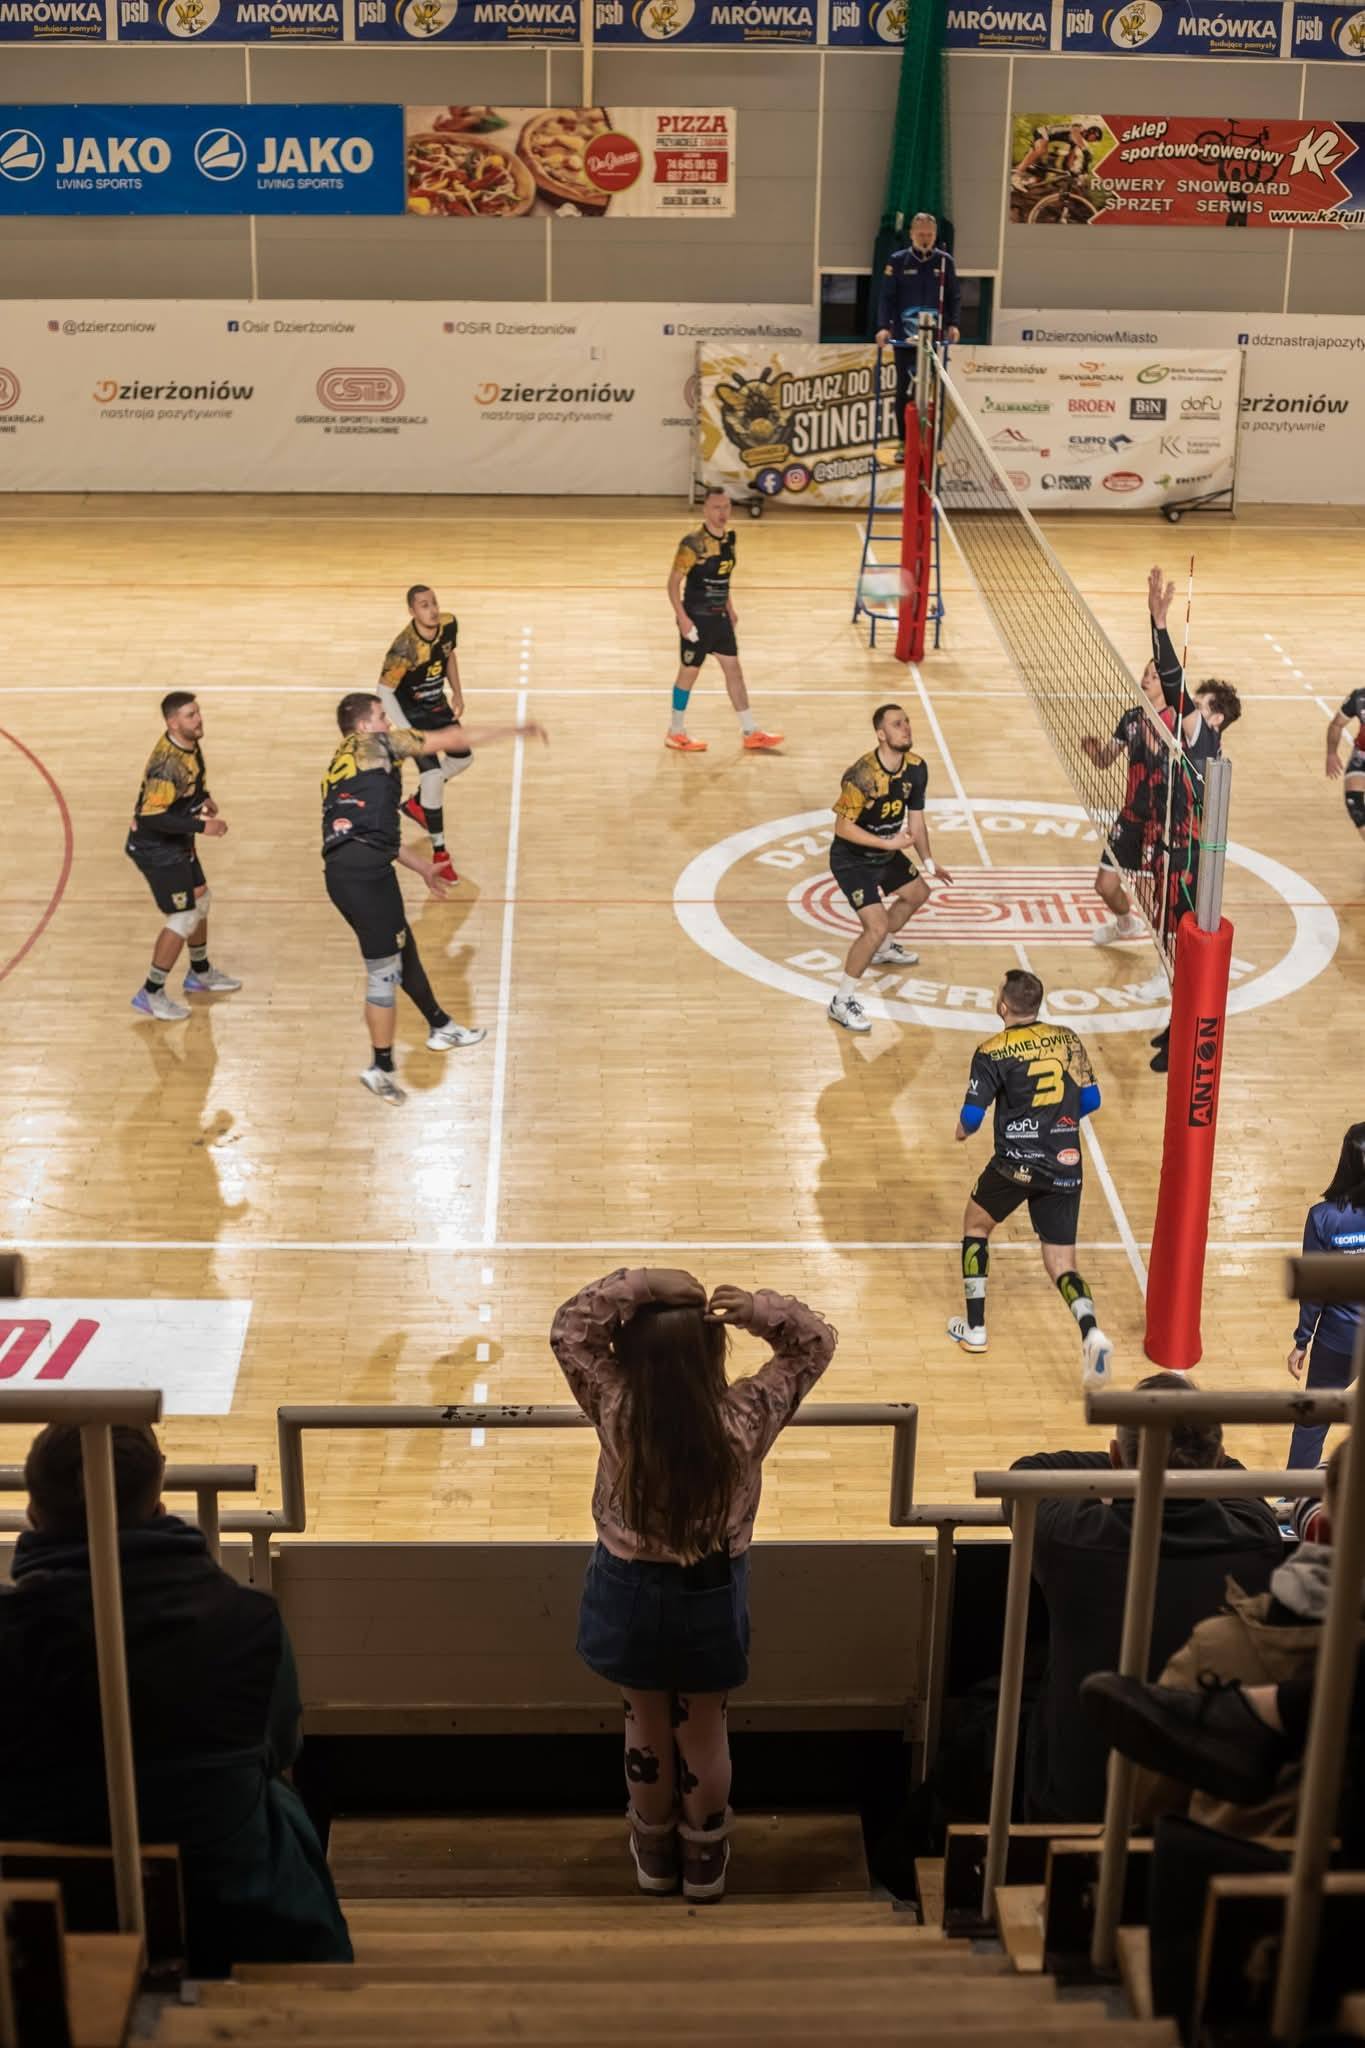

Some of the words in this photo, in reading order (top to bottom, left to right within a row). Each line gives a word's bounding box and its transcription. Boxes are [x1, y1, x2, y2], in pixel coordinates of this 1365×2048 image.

[0, 0, 102, 21] MRÓWKA
[236, 0, 339, 22] MRÓWKA
[359, 0, 386, 27] psb
[474, 0, 576, 23] MRÓWKA
[710, 1, 813, 25] MRÓWKA
[832, 2, 860, 31] psb
[946, 6, 1047, 32] MRÓWKA
[1066, 9, 1094, 38] psb
[1177, 13, 1277, 39] MRÓWKA
[1296, 16, 1323, 45] psb
[657, 116, 727, 133] PIZZA
[1121, 121, 1167, 142] sklep
[56, 137, 171, 174] JAKO
[257, 137, 374, 174] JAKO
[1120, 141, 1284, 166] sportowo-rowerowy
[1289, 127, 1343, 182] K2
[56, 178, 93, 190] LIVING
[95, 178, 142, 190] SPORTS
[257, 178, 295, 190] LIVING
[298, 178, 344, 190] SPORTS
[1090, 178, 1165, 192] ROWERY
[1177, 180, 1290, 195] SNOWBOARD
[1105, 198, 1173, 214] SPRZĘT
[1197, 200, 1263, 213] SERWIS
[63, 320, 156, 335] @dzierzoniow
[274, 320, 355, 334] Dzierżoniów
[496, 322, 576, 335] Dzierżoniów
[1035, 330, 1158, 344] DzierzoniowMiasto
[782, 374, 842, 408] DOŁĄCZ
[848, 369, 870, 396] DO
[1068, 399, 1116, 412] BROEN
[1253, 420, 1325, 433] pozytywnie
[1069, 435, 1106, 445] EURO
[880, 799, 903, 819] 99
[1027, 1057, 1065, 1107] 3
[1189, 1017, 1219, 1126] ANTON
